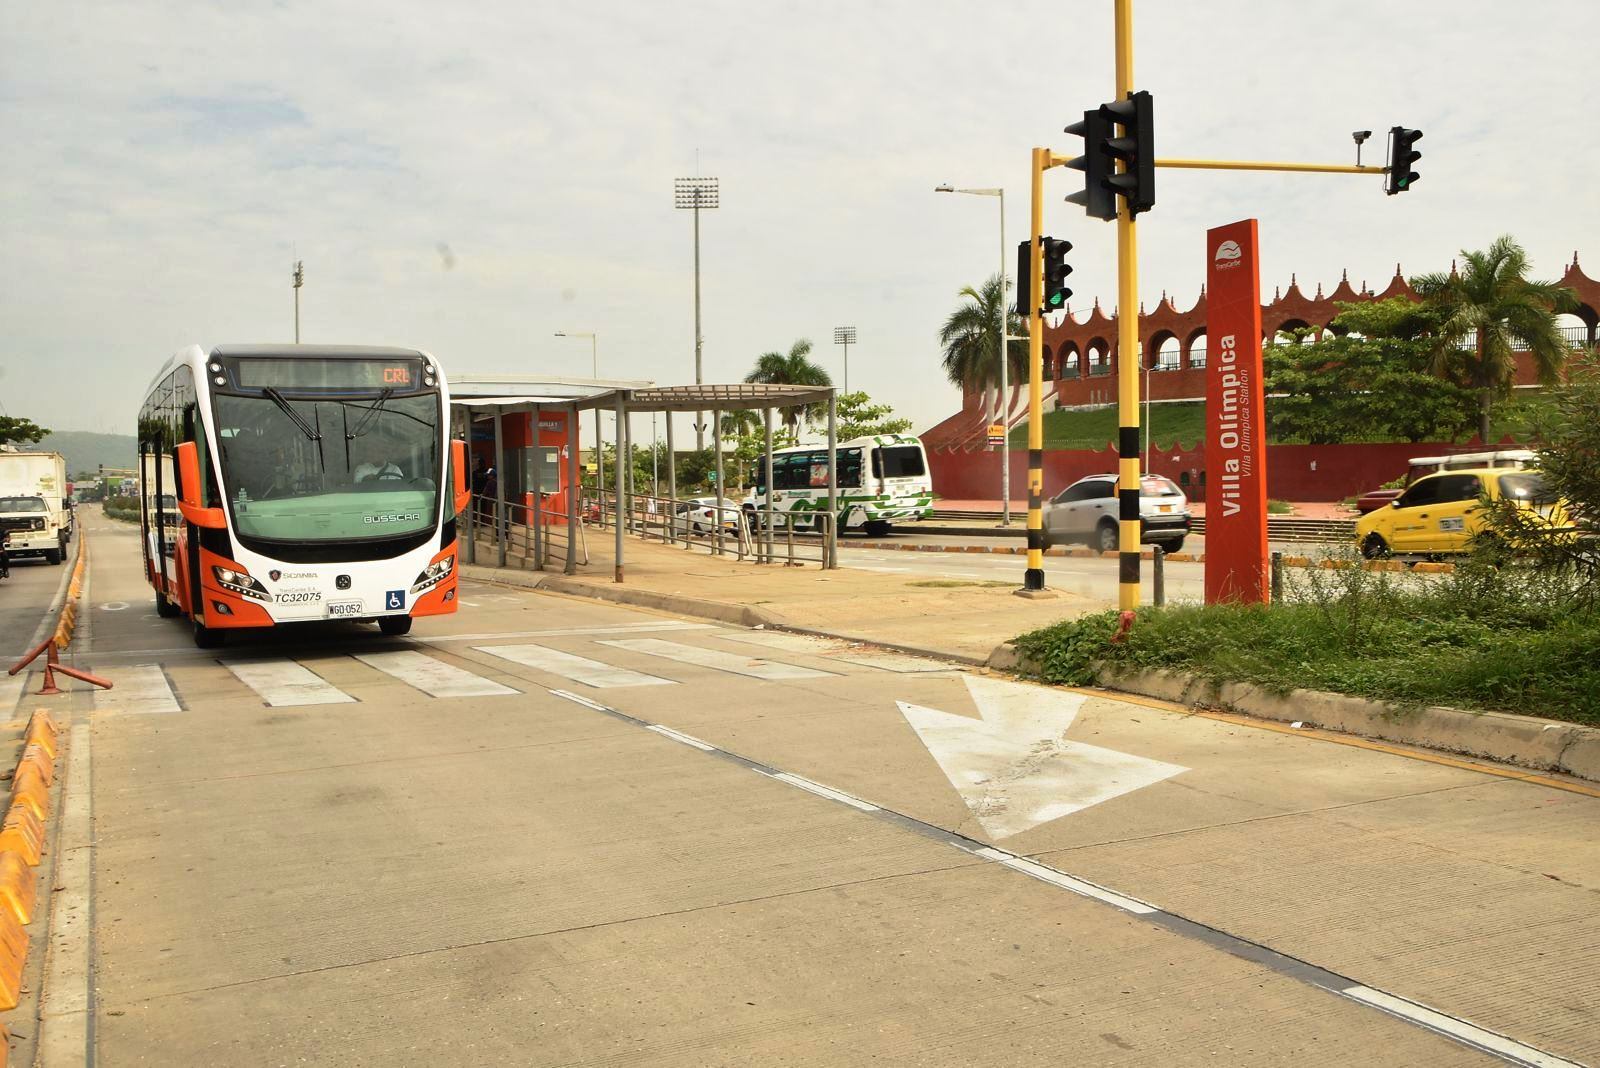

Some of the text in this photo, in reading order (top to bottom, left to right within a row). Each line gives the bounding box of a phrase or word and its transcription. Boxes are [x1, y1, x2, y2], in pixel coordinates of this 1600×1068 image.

[1239, 369, 1249, 405] Station
[1218, 335, 1241, 517] Villa Olímpica
[1242, 455, 1251, 477] Villa
[363, 513, 420, 524] BUSSCAR
[274, 592, 321, 603] TC32075
